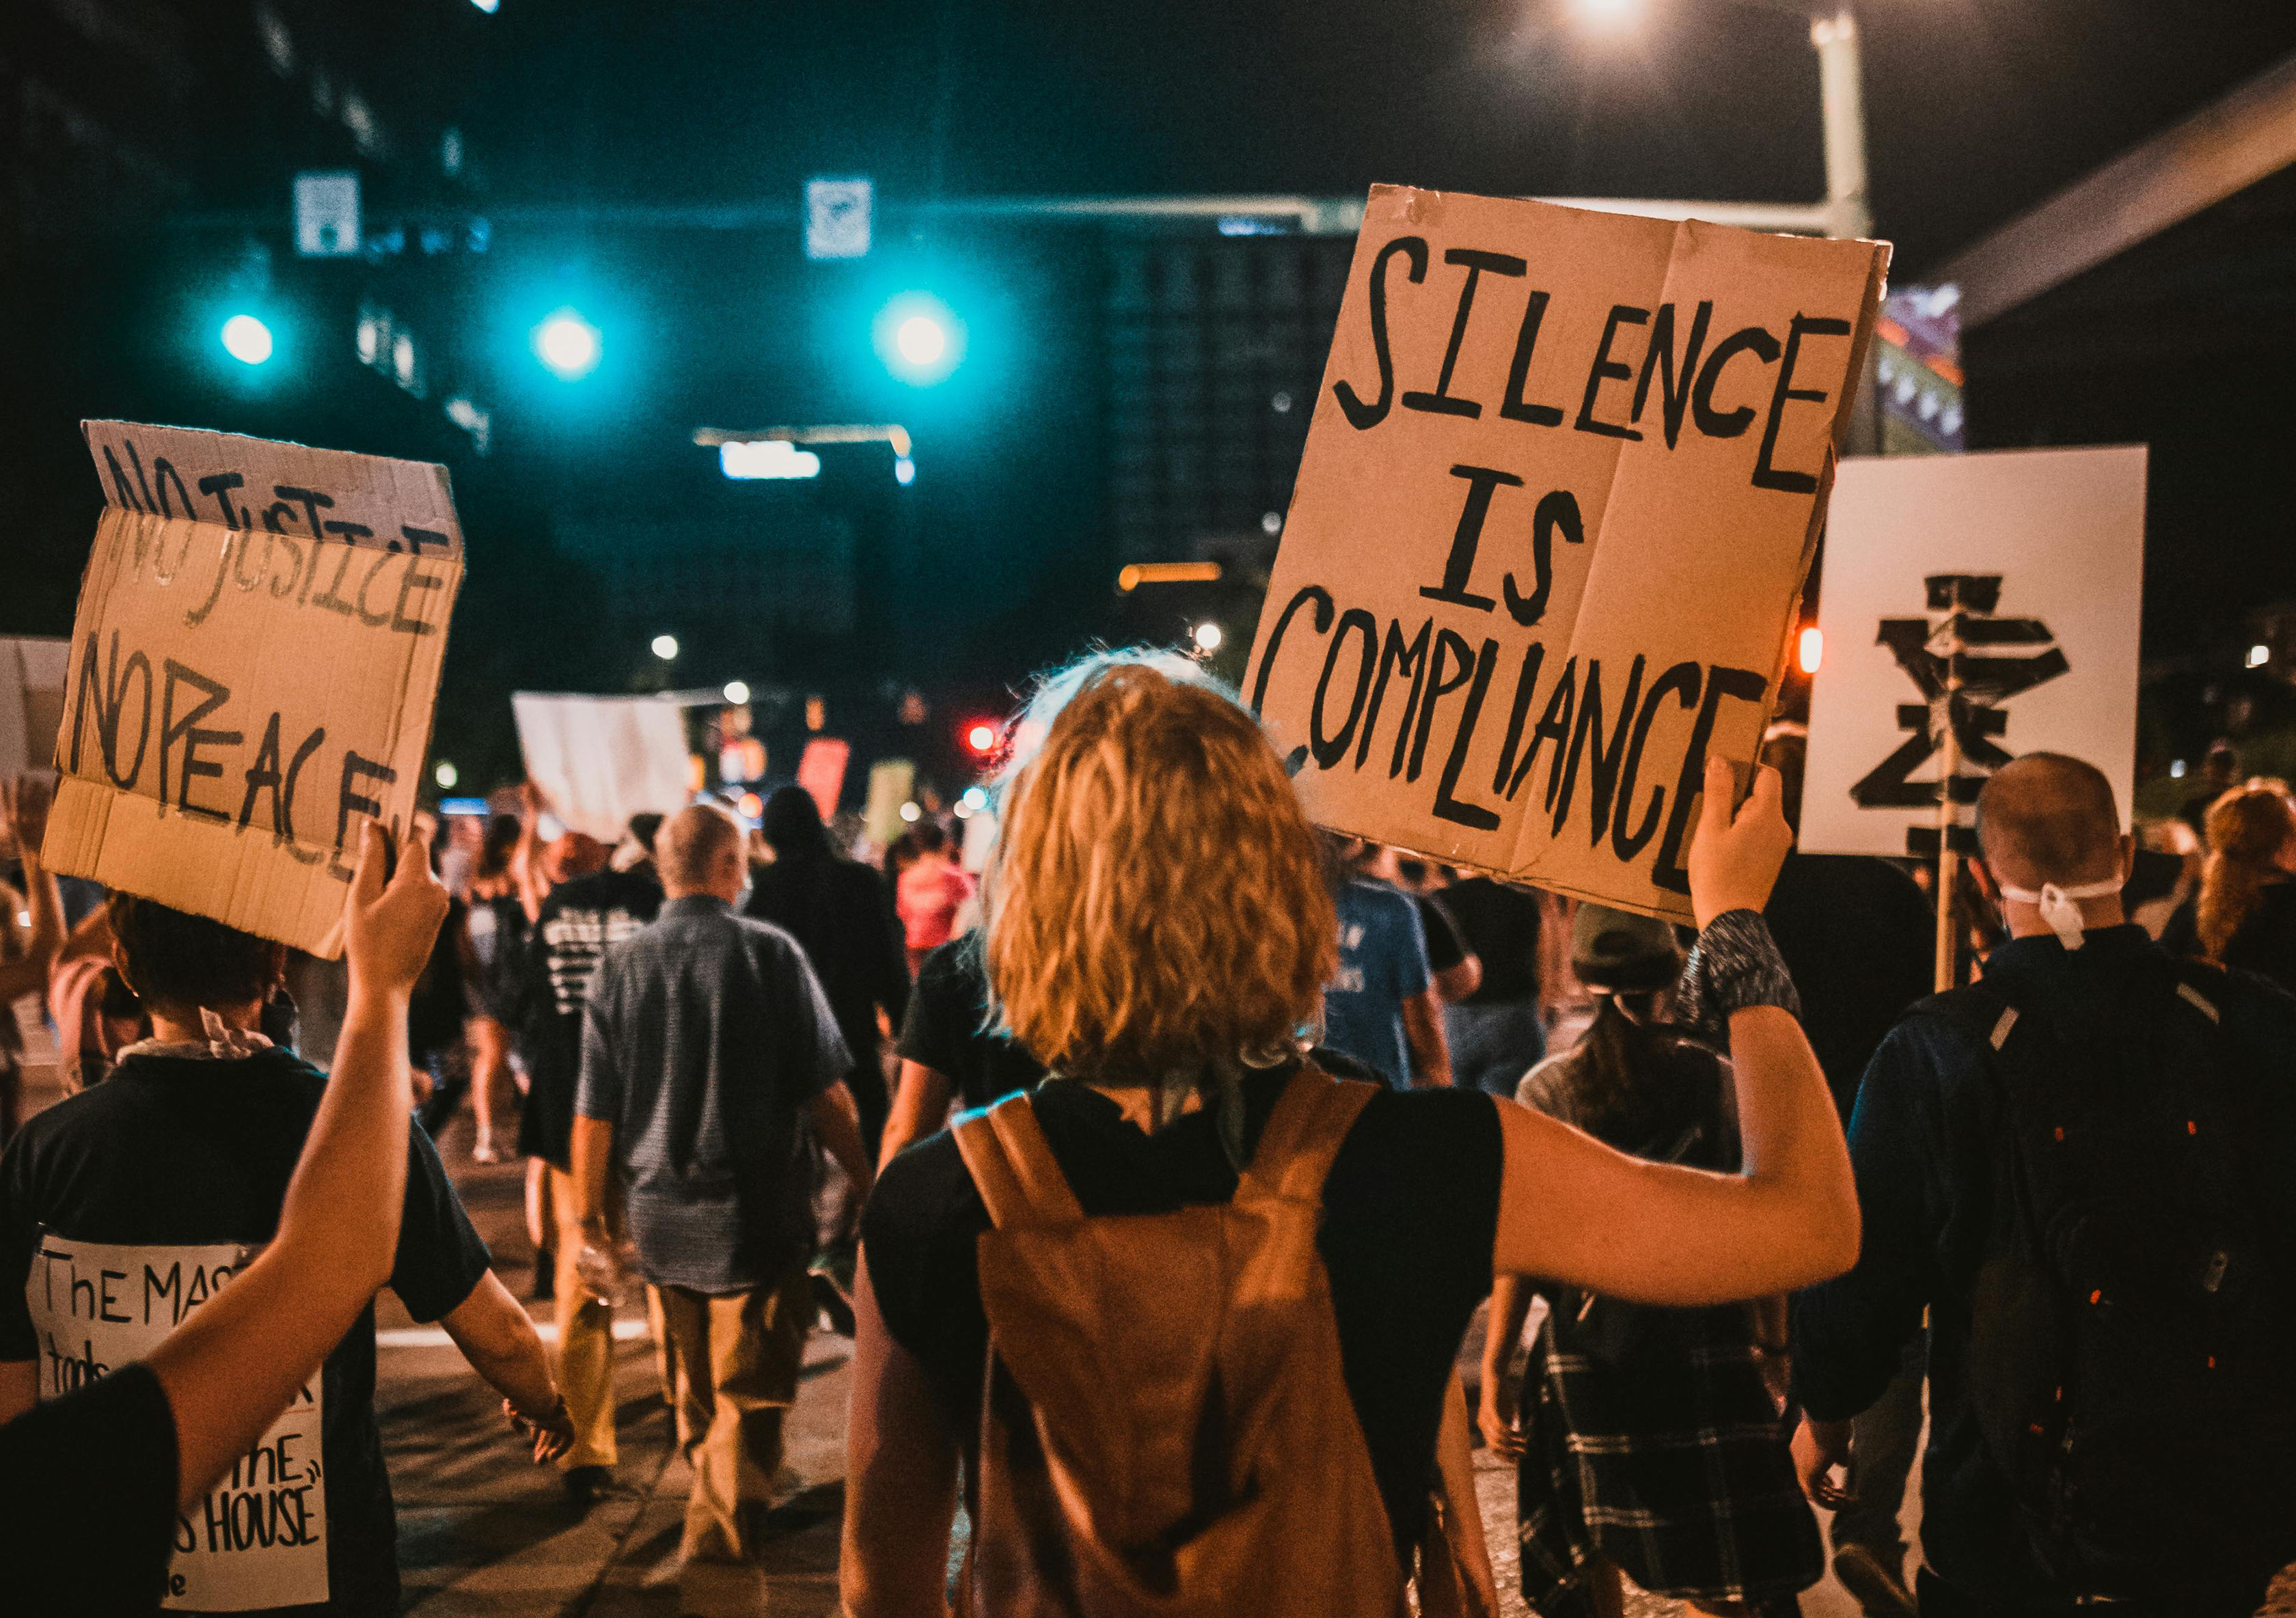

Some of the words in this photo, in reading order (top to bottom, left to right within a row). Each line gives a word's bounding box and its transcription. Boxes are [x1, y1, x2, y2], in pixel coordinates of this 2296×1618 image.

[1332, 236, 1851, 495] SILENCE
[102, 439, 198, 586] NO
[1419, 464, 1585, 627] IS
[70, 629, 153, 791] NO
[159, 656, 397, 883] PEACE
[1250, 584, 1769, 894] COMPLIANCE
